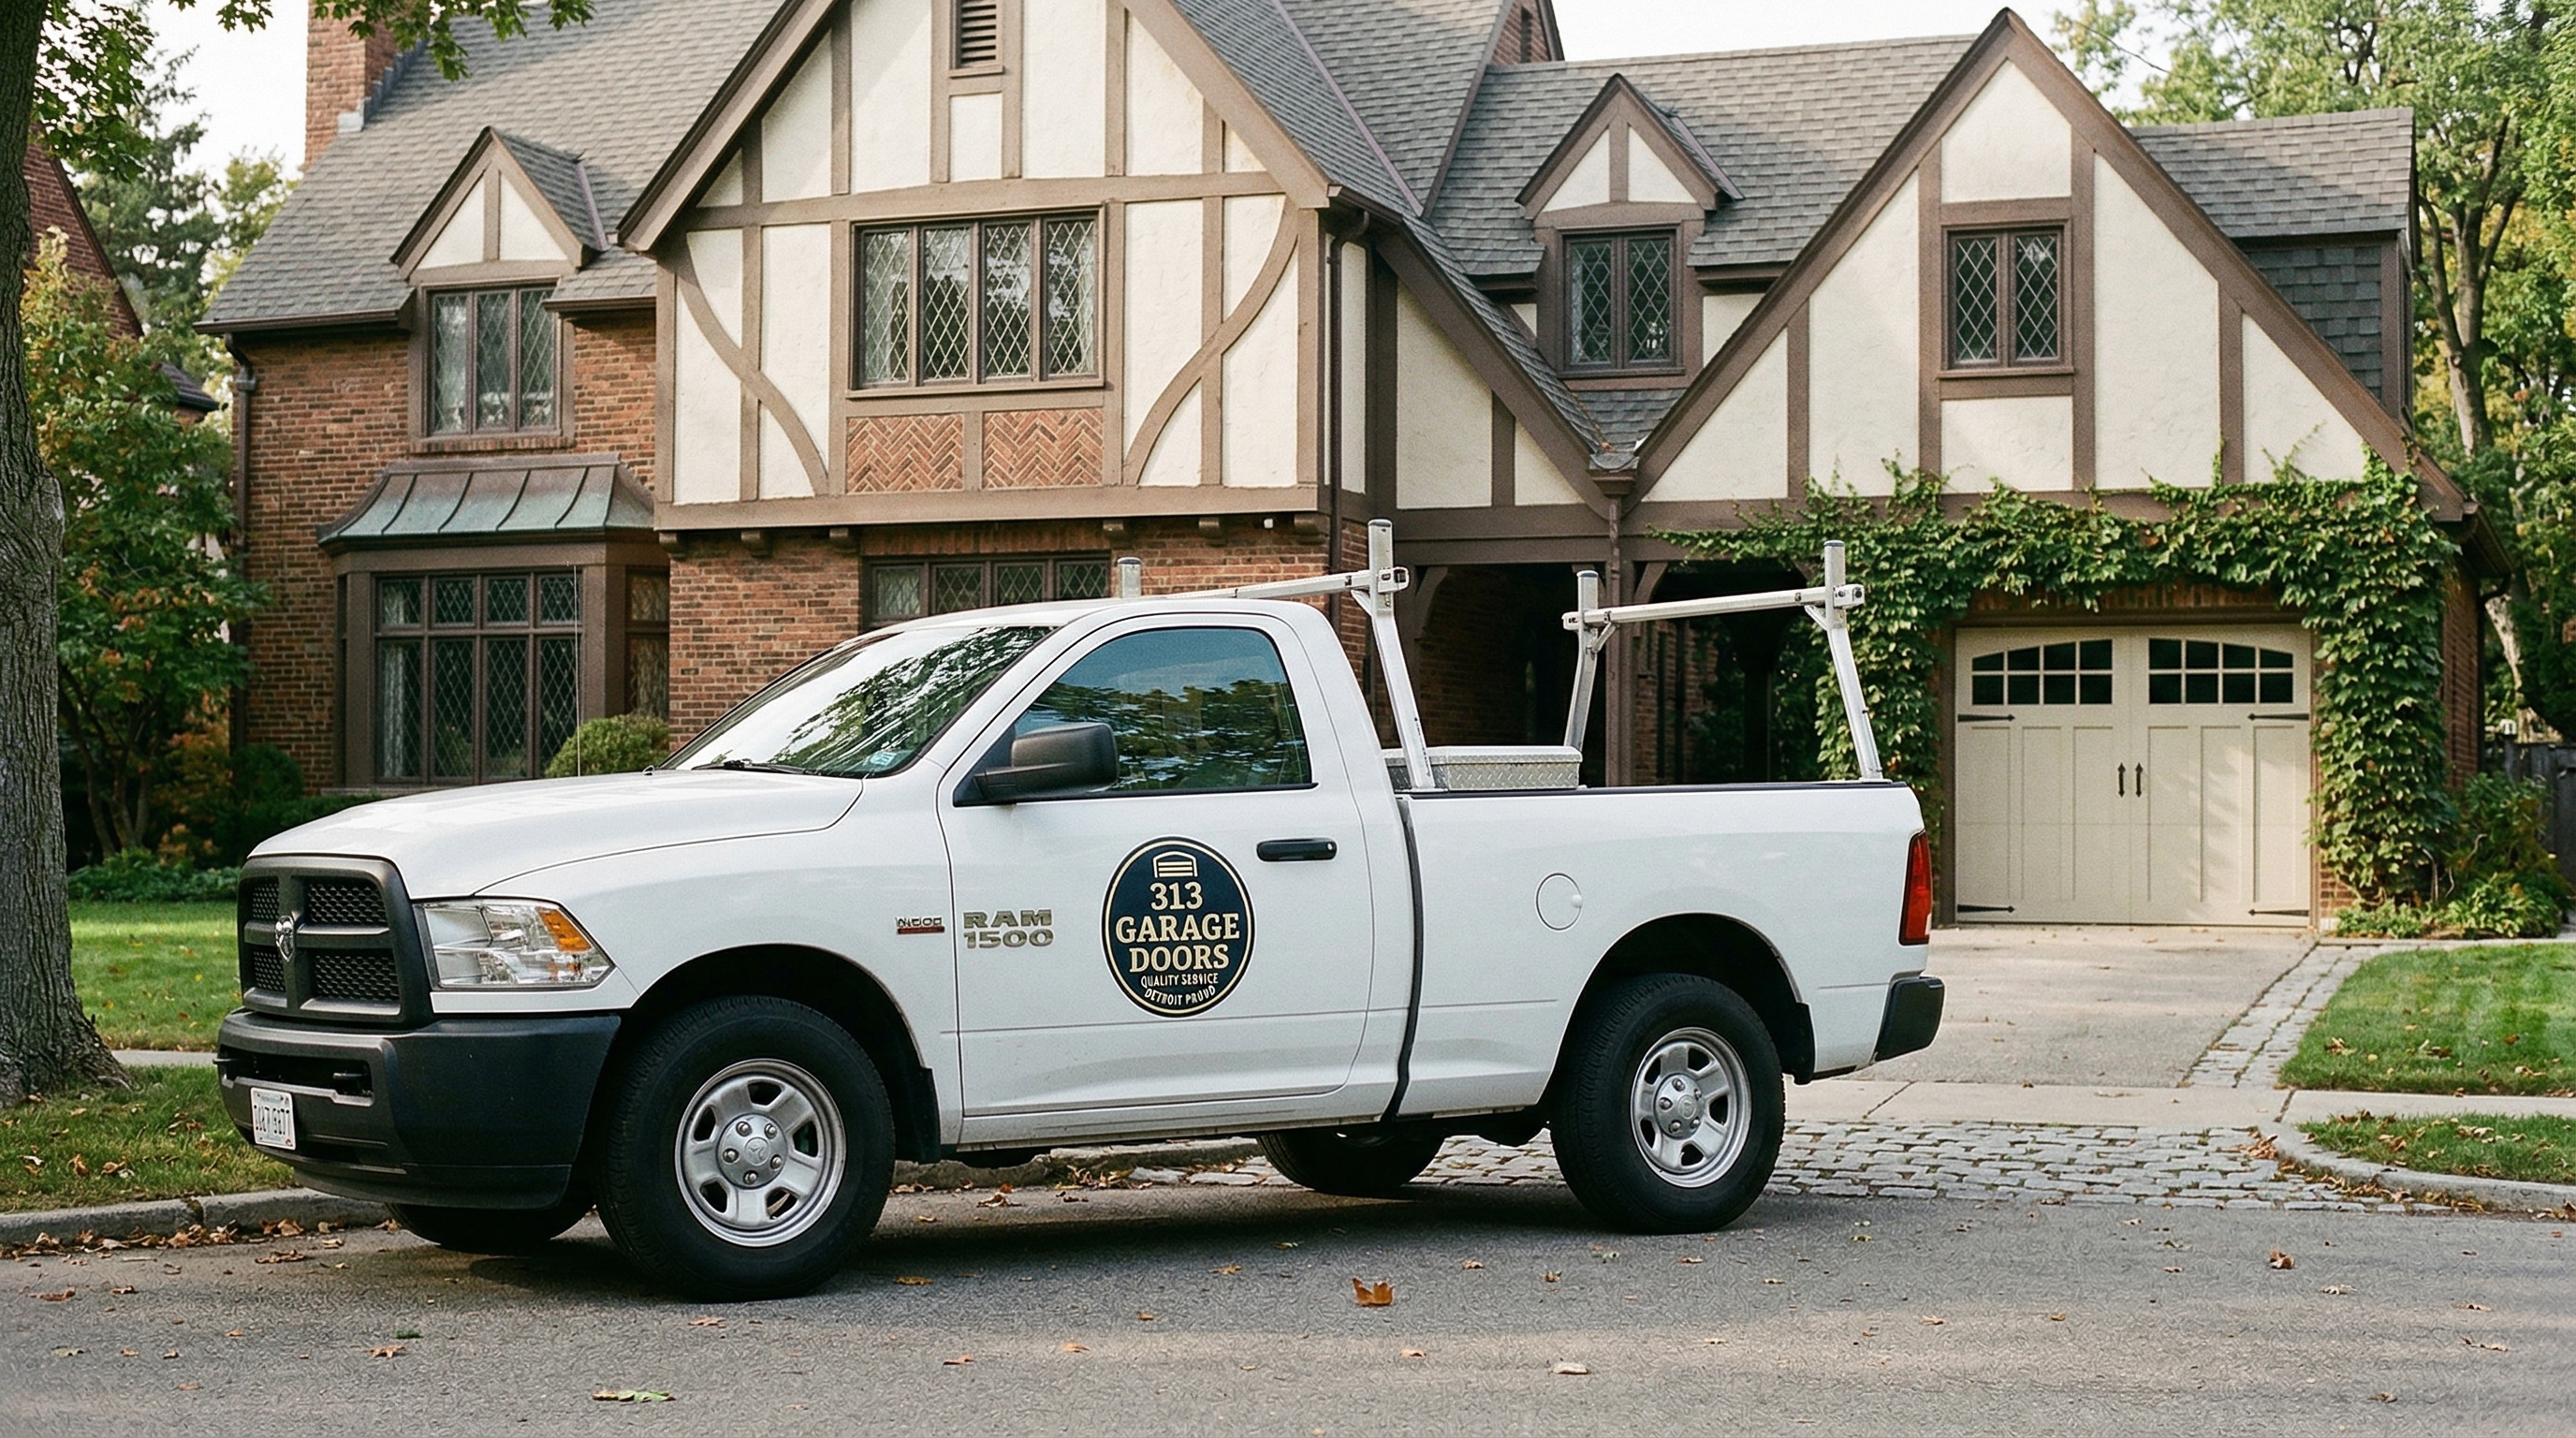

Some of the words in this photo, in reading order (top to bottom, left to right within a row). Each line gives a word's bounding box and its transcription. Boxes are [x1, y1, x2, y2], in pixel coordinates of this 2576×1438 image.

[1149, 881, 1203, 911] 313
[963, 909, 1052, 929] RAM
[1115, 913, 1240, 944] GARAGE
[963, 929, 1054, 949] 1500
[1129, 944, 1229, 973] DOORS
[1140, 975, 1179, 989] QUALITY
